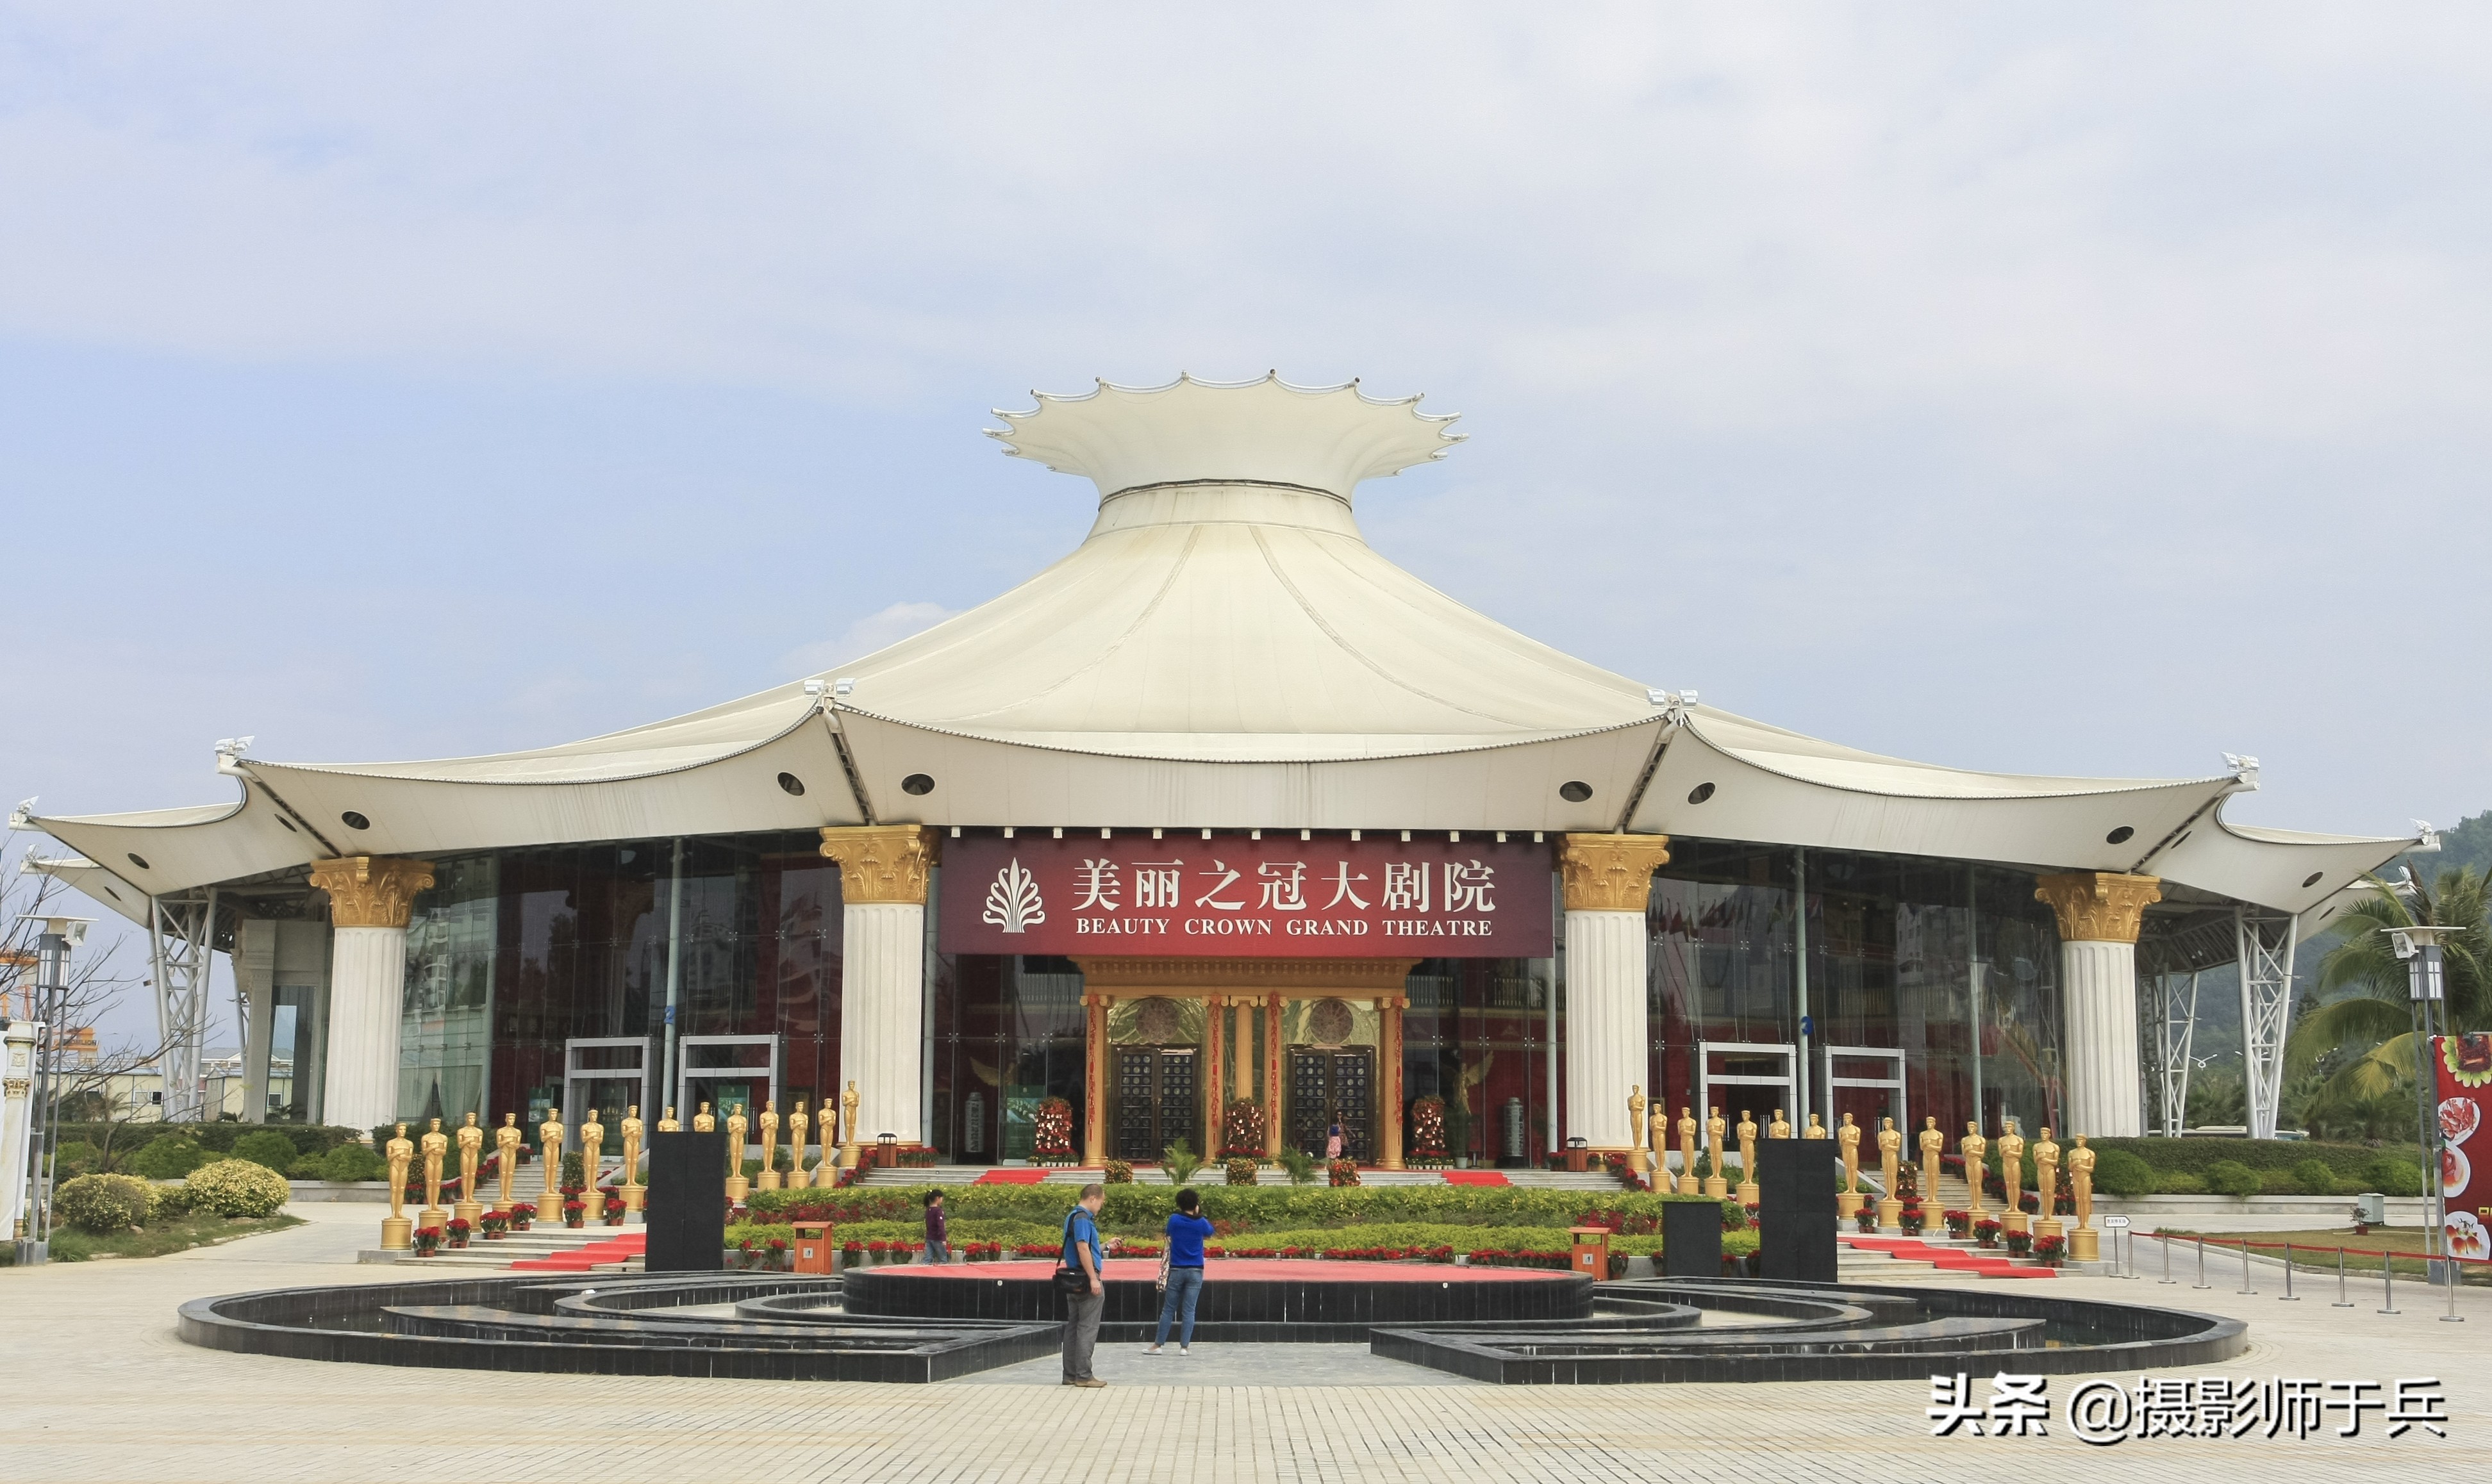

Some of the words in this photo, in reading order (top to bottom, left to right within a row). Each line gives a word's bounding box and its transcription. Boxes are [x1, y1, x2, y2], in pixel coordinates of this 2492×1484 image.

[1072, 858, 1496, 913] 美丽之冠大剧院
[1076, 918, 1170, 935] BEAUTY
[1184, 918, 1272, 936] CROWN
[1286, 918, 1368, 936] GRAND
[1383, 919, 1493, 936] THEATRE
[663, 1005, 676, 1024] 2
